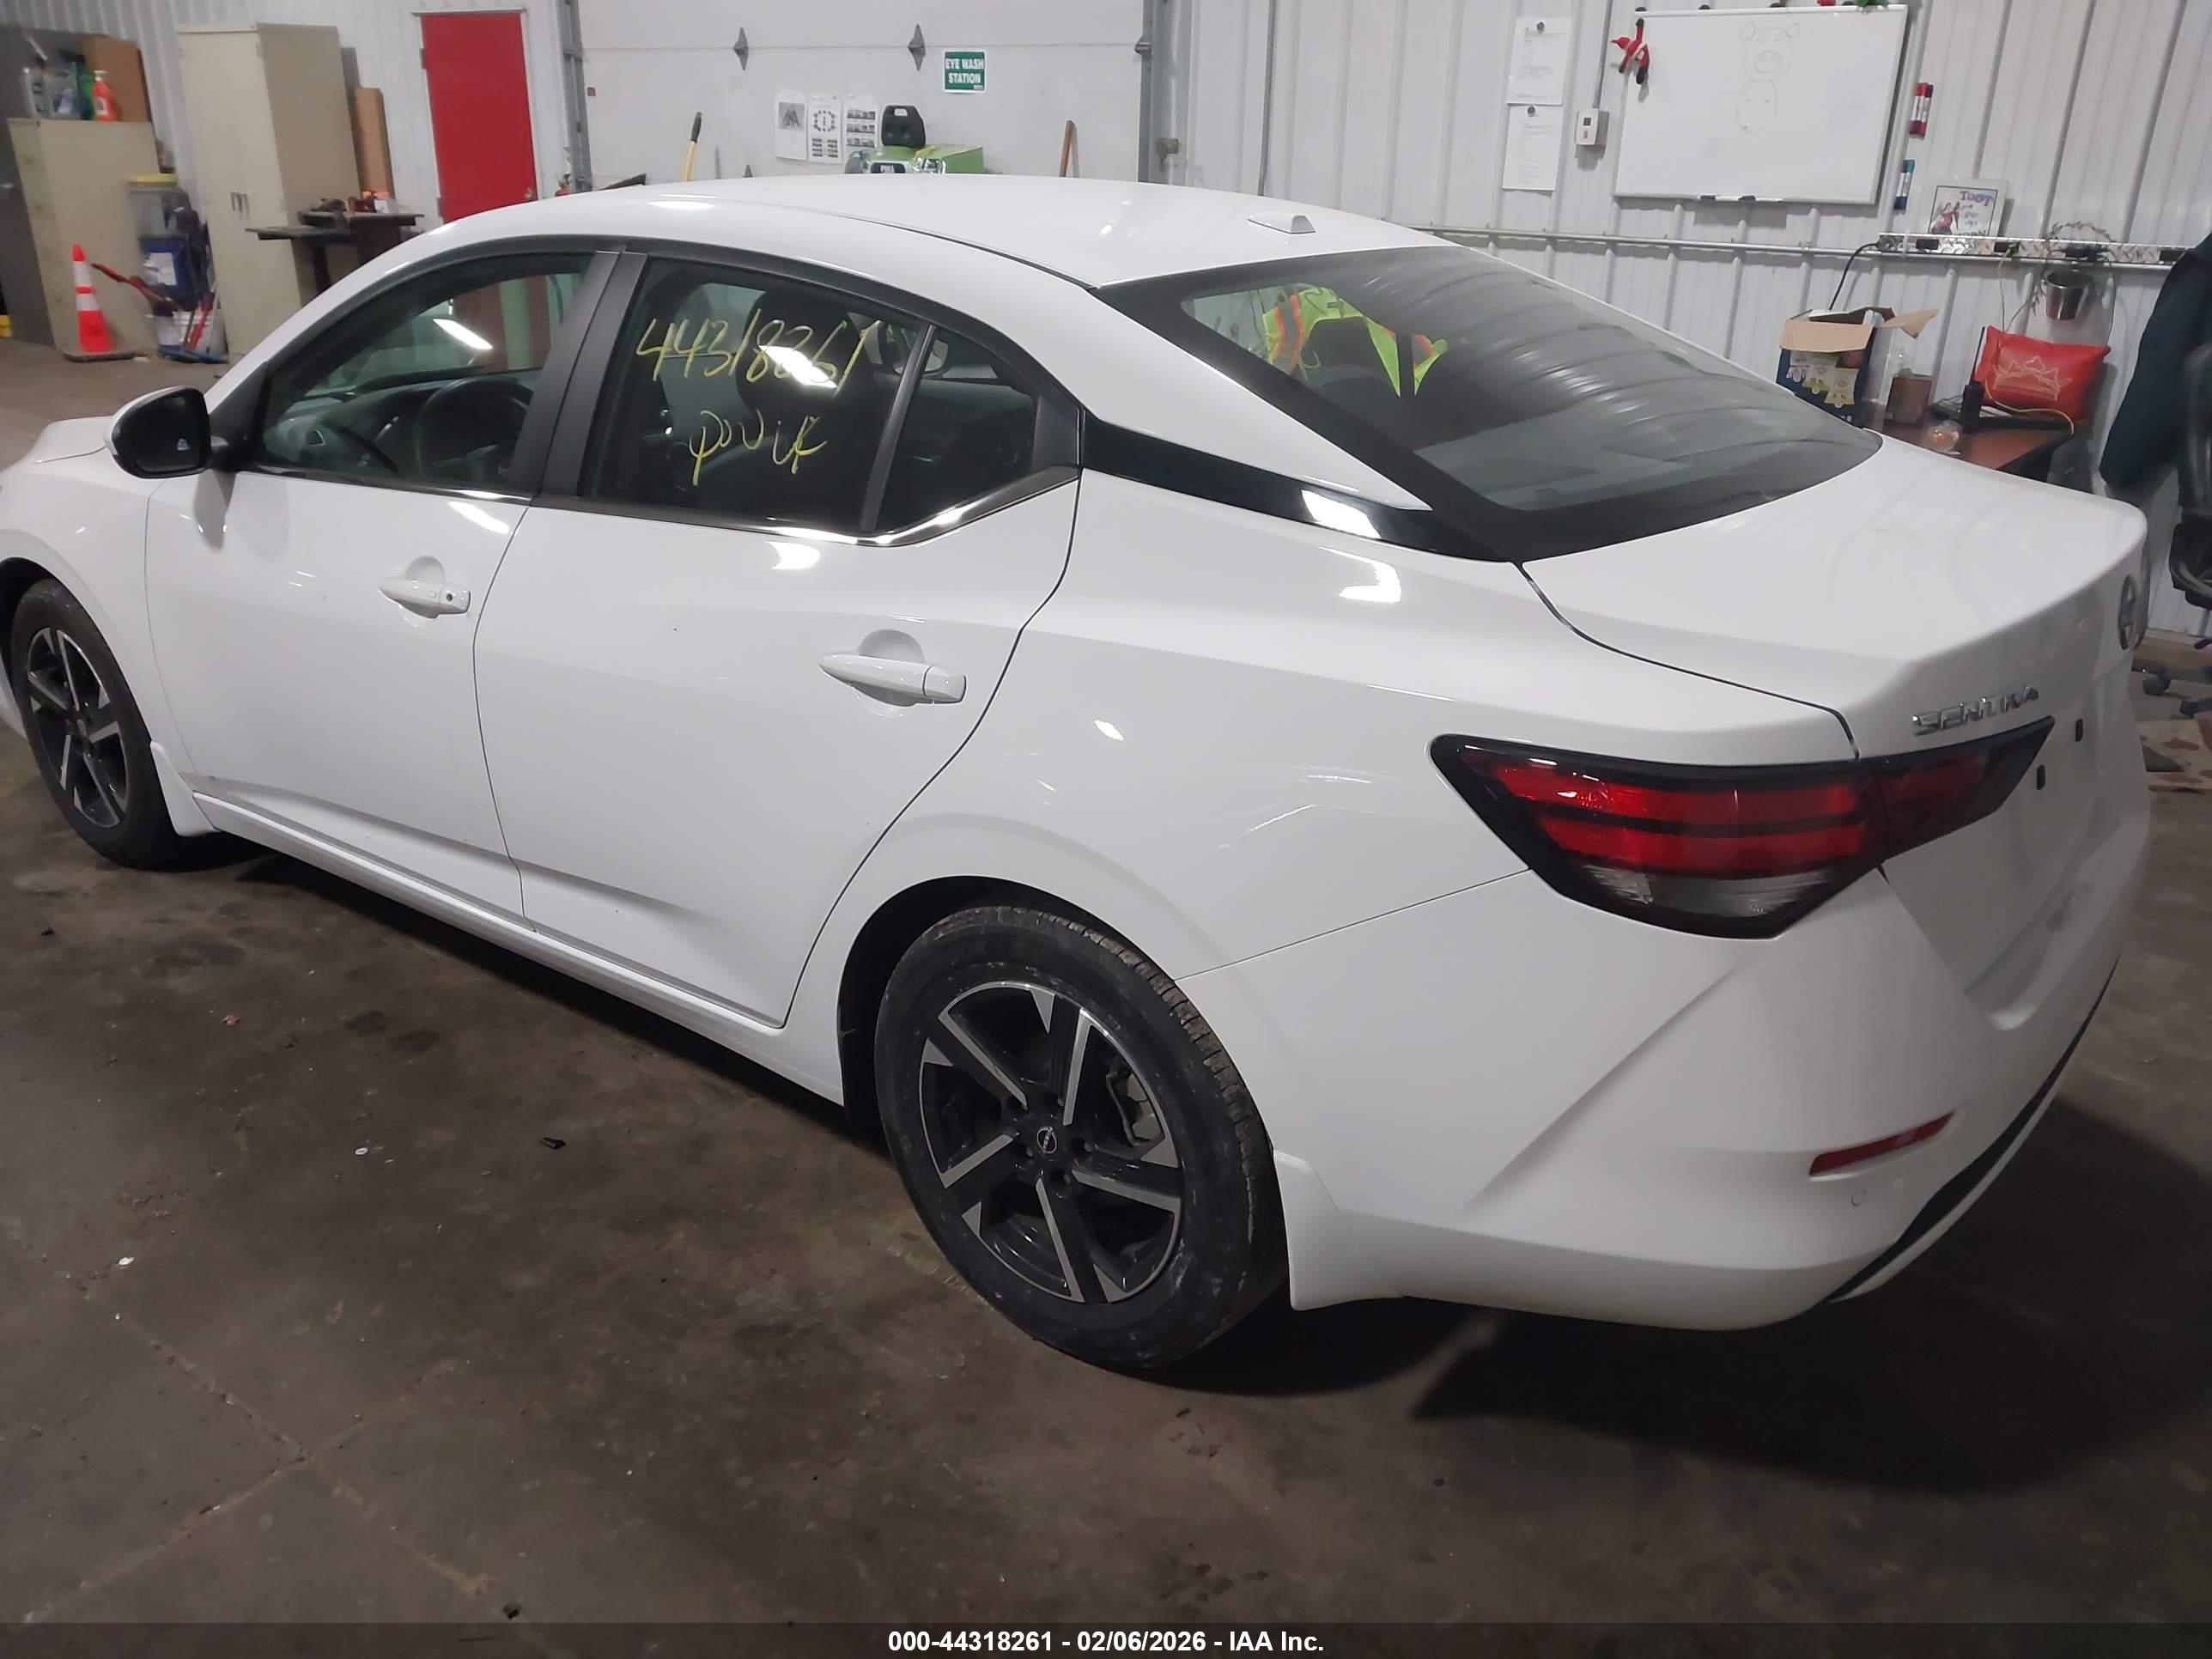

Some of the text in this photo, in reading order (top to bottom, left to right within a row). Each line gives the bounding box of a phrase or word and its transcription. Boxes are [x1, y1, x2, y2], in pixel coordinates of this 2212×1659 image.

[945, 58, 984, 70] EYE WASH
[948, 73, 981, 84] STATION
[1912, 685, 2039, 737] SENTRA
